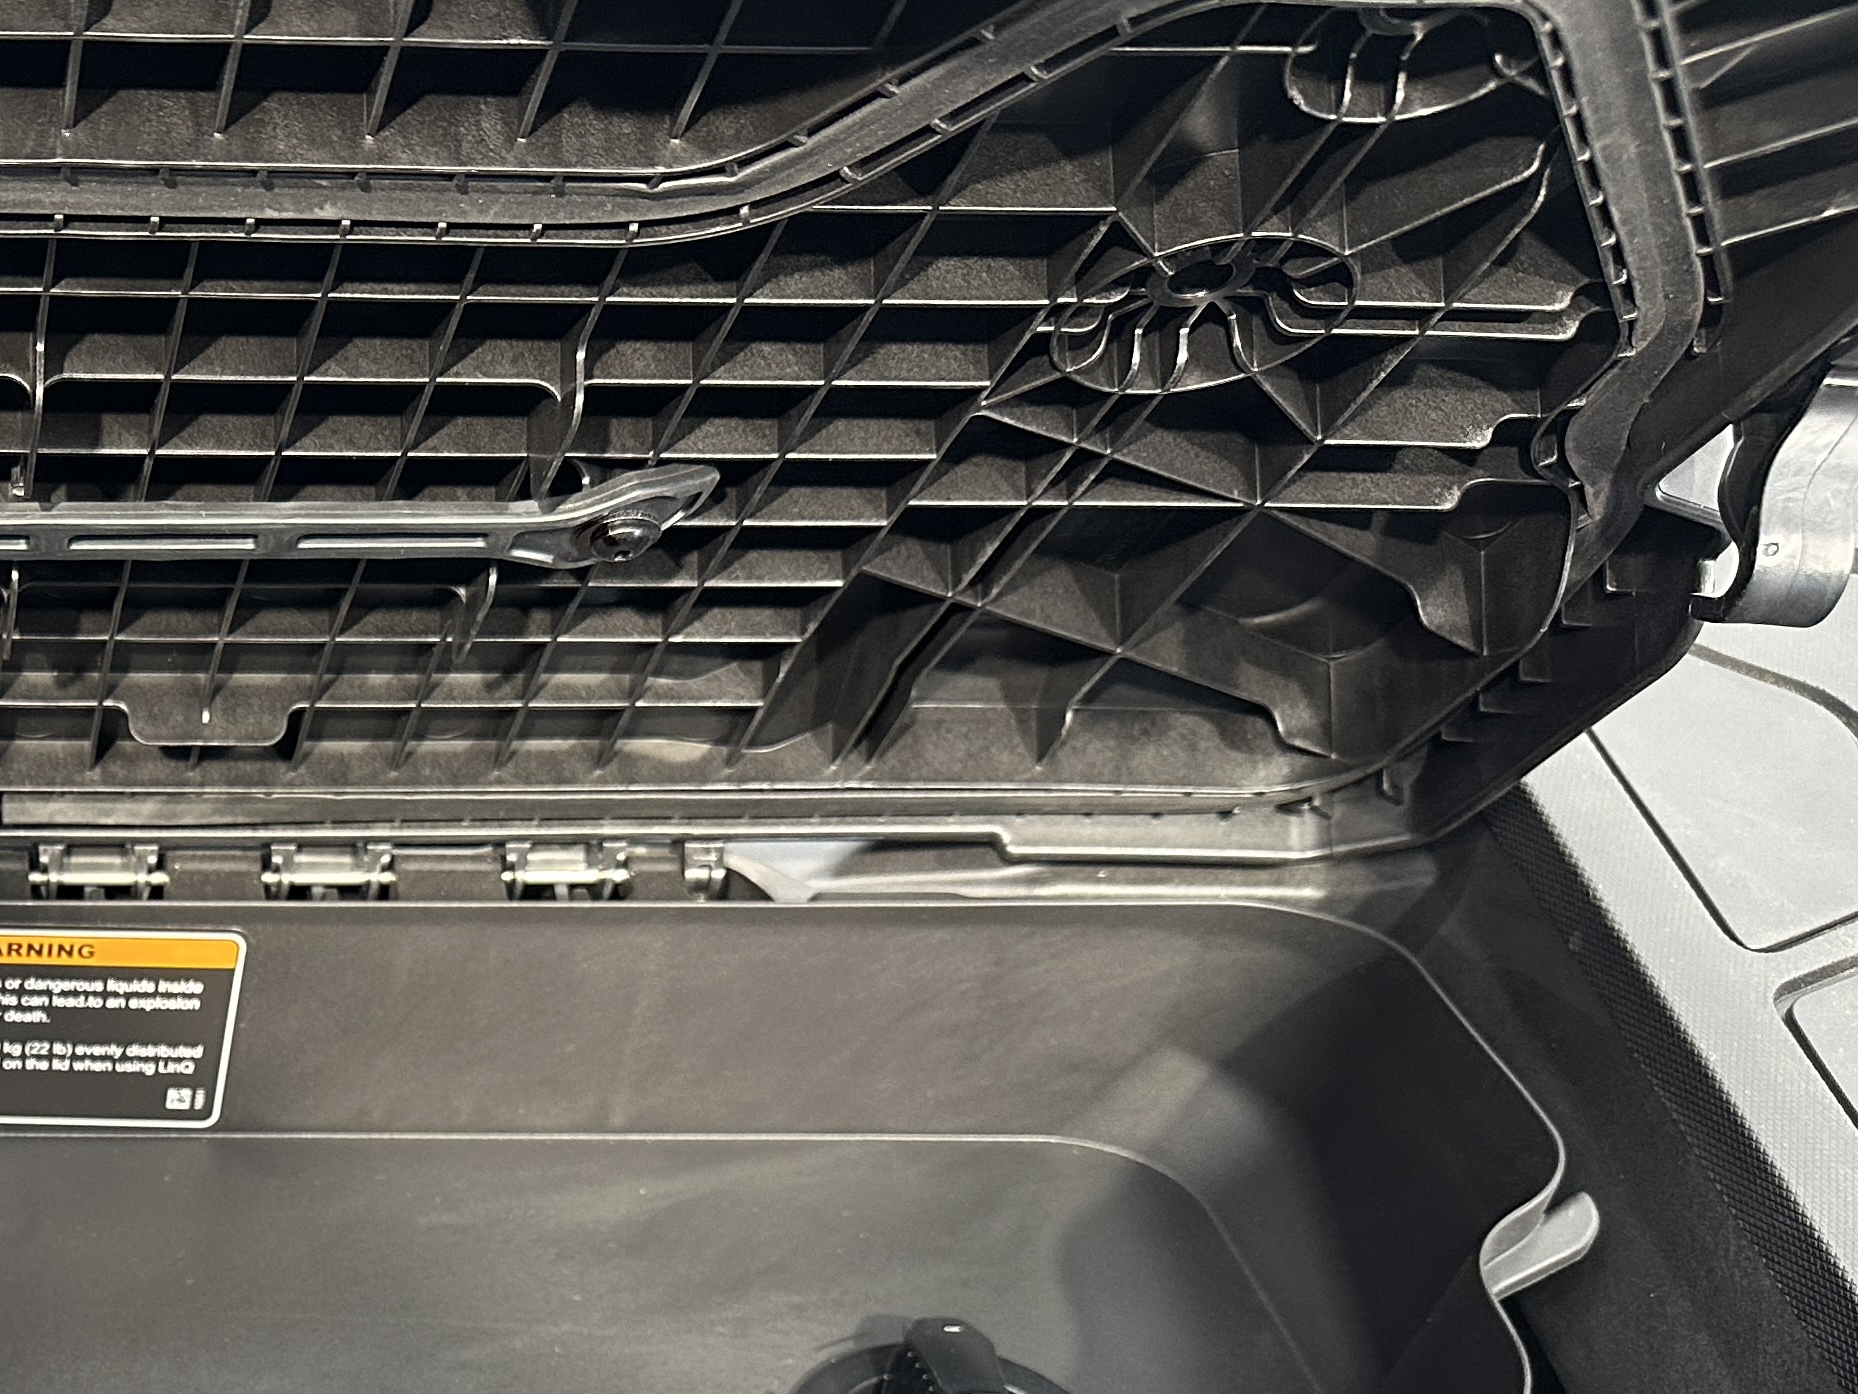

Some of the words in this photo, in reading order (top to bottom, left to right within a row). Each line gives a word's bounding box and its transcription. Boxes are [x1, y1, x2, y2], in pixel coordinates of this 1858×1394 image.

[5, 978, 21, 990] or
[24, 976, 104, 993] dangerous
[106, 978, 156, 994] liquids
[158, 978, 204, 994] inside
[21, 995, 49, 1007] can
[52, 993, 85, 1008] lead
[86, 994, 103, 1008] to
[105, 996, 126, 1008] an
[128, 994, 201, 1011] explosion
[3, 1009, 50, 1023] death.
[3, 1040, 22, 1056] kg
[25, 1040, 50, 1056] (22
[52, 1041, 72, 1058] lb)
[75, 1043, 124, 1059] evenly
[126, 1043, 204, 1058] distributed
[2, 1058, 22, 1070] on
[25, 1058, 49, 1070] the
[51, 1058, 70, 1071] lid
[72, 1059, 113, 1072] when
[115, 1060, 156, 1076] using
[158, 1059, 196, 1074] LinQ
